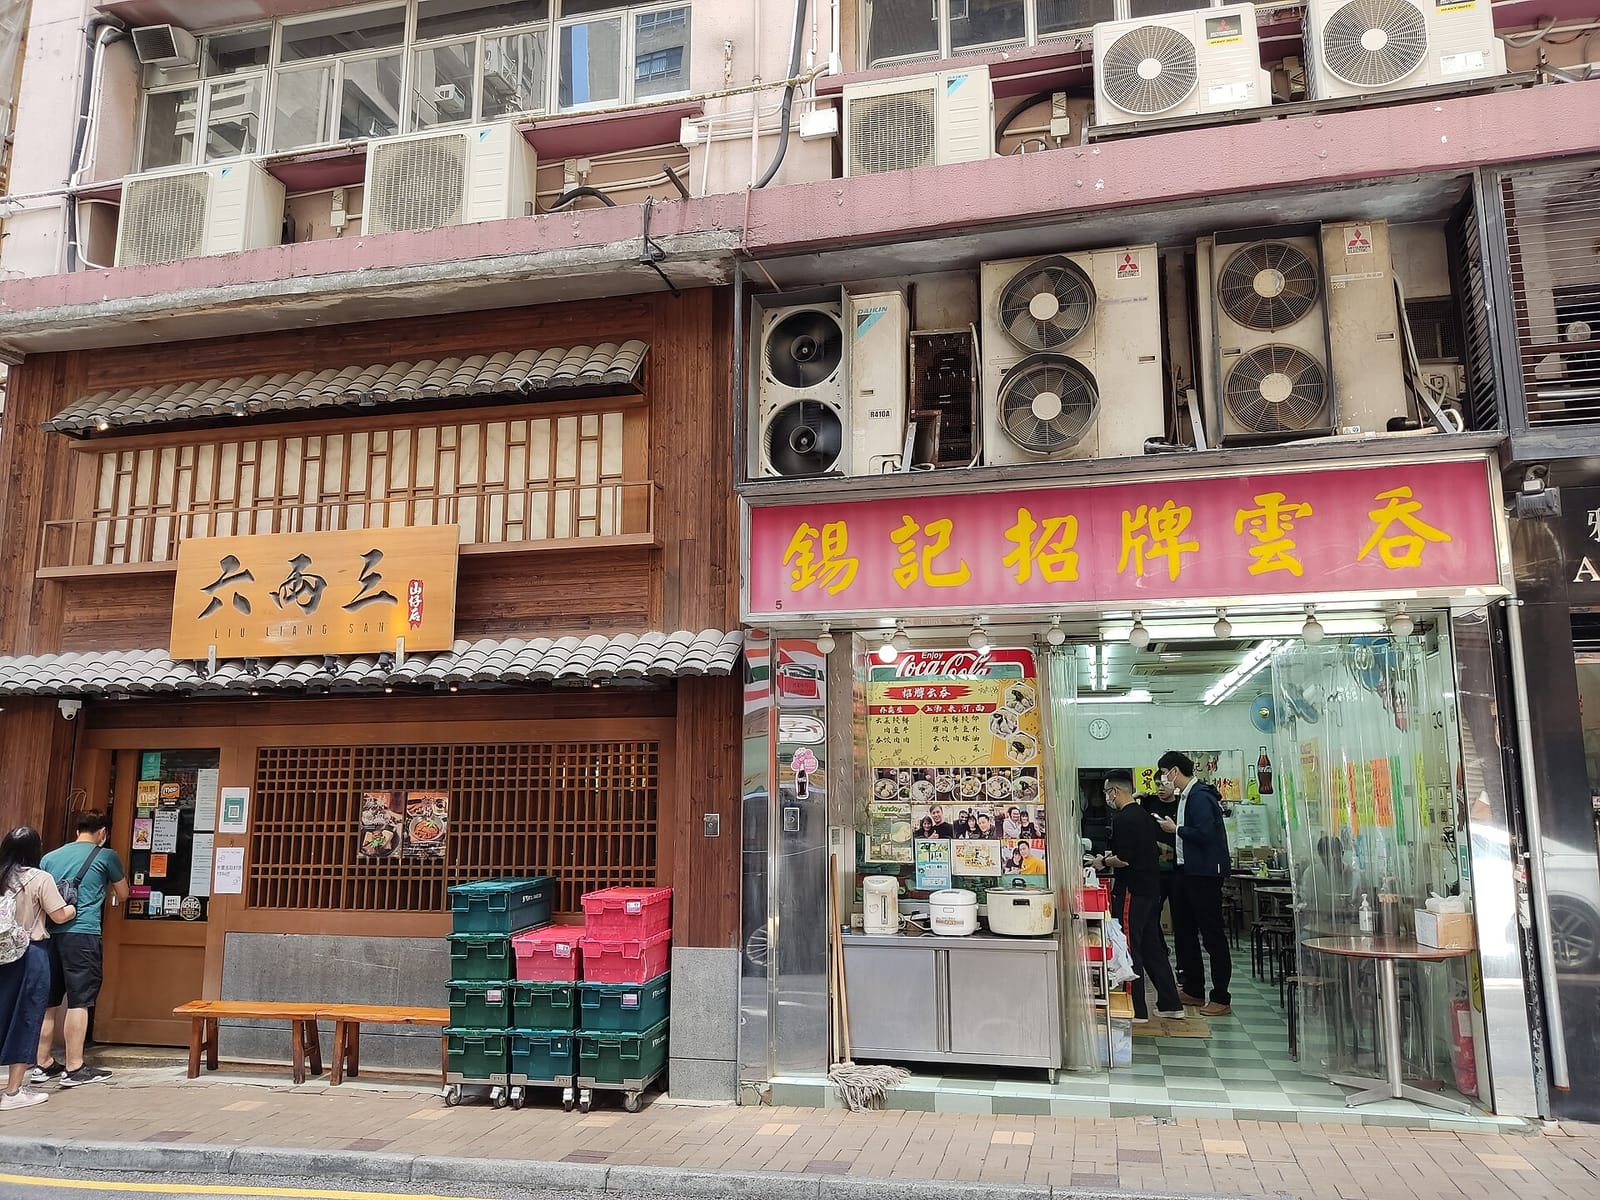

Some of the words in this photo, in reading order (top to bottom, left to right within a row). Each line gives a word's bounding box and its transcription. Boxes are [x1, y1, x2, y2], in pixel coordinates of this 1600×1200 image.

[857, 305, 888, 315] DAIKIN
[869, 410, 891, 419] R410A
[782, 486, 1453, 596] 錫記招牌雲吞
[775, 600, 782, 610] 5
[214, 623, 246, 639] LIU
[265, 622, 328, 638] LIANG
[348, 621, 386, 634] SAN
[921, 651, 944, 660] Enjoy
[895, 653, 992, 679] Coca-Cola
